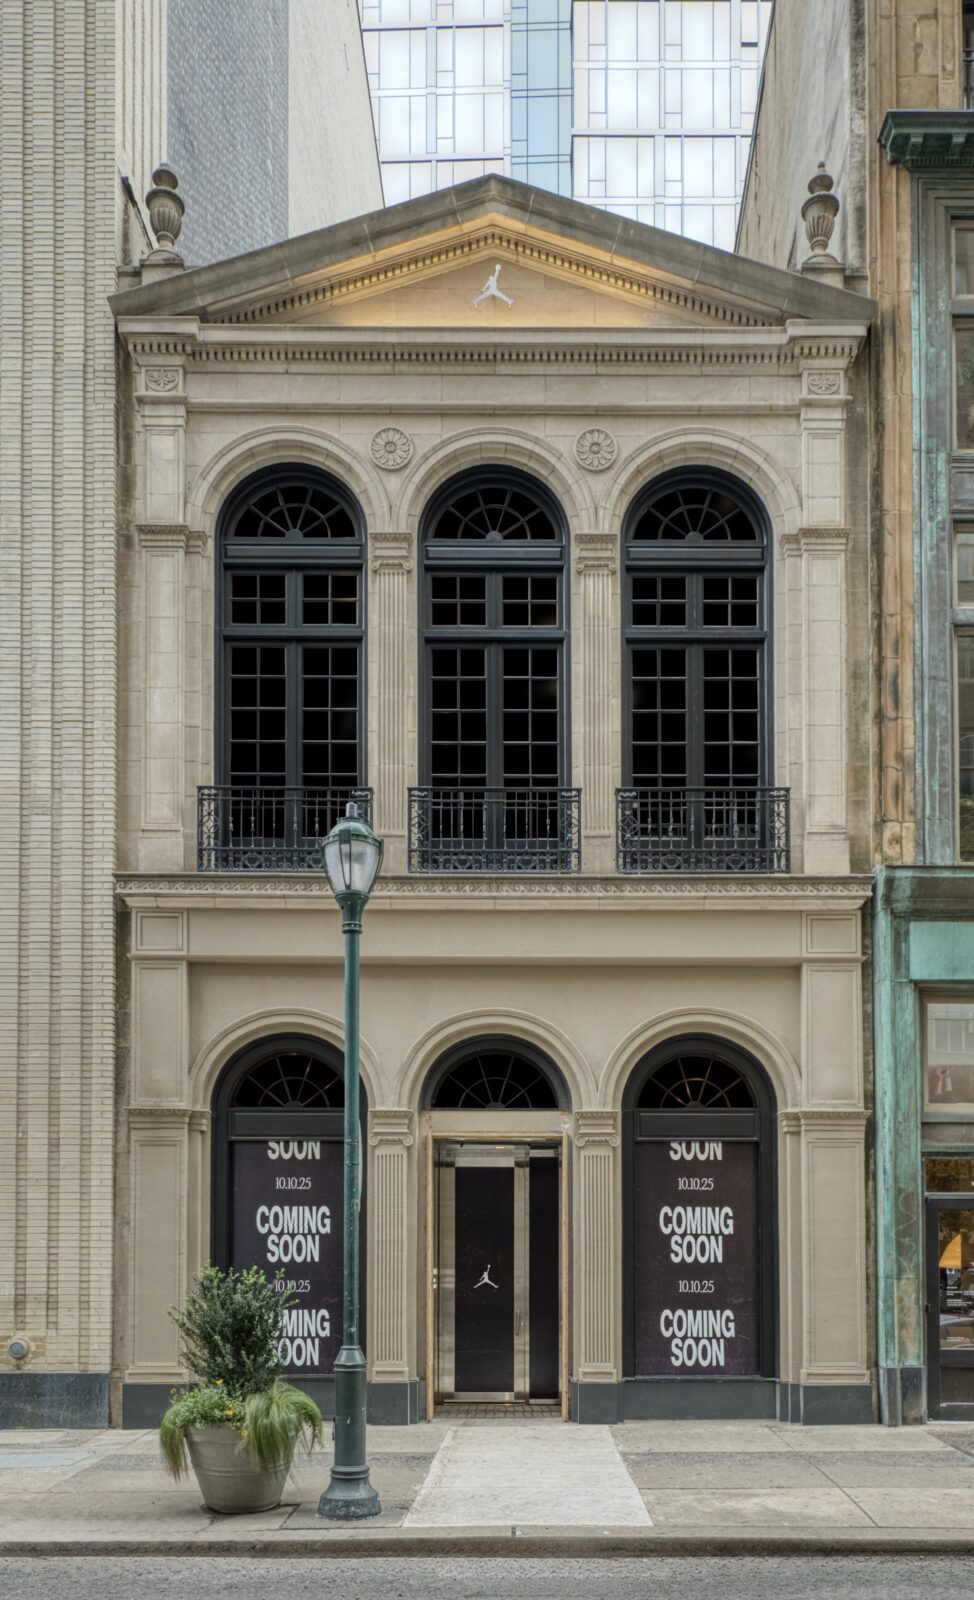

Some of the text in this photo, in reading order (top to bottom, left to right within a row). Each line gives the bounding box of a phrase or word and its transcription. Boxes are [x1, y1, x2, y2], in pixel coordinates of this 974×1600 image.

[267, 1141, 320, 1160] SOON
[669, 1141, 723, 1161] SOON
[275, 1177, 312, 1190] 10.10.25
[677, 1177, 714, 1190] 10.10.25
[256, 1206, 331, 1234] COMING
[659, 1206, 734, 1235] COMING
[266, 1235, 320, 1263] SOON
[670, 1235, 723, 1263] SOON
[275, 1280, 311, 1293] 10.10.25
[678, 1280, 715, 1293] 10.10.25
[270, 1309, 331, 1338] MING
[660, 1309, 735, 1338] COMING
[272, 1338, 320, 1367] OON
[670, 1338, 725, 1367] SOON
